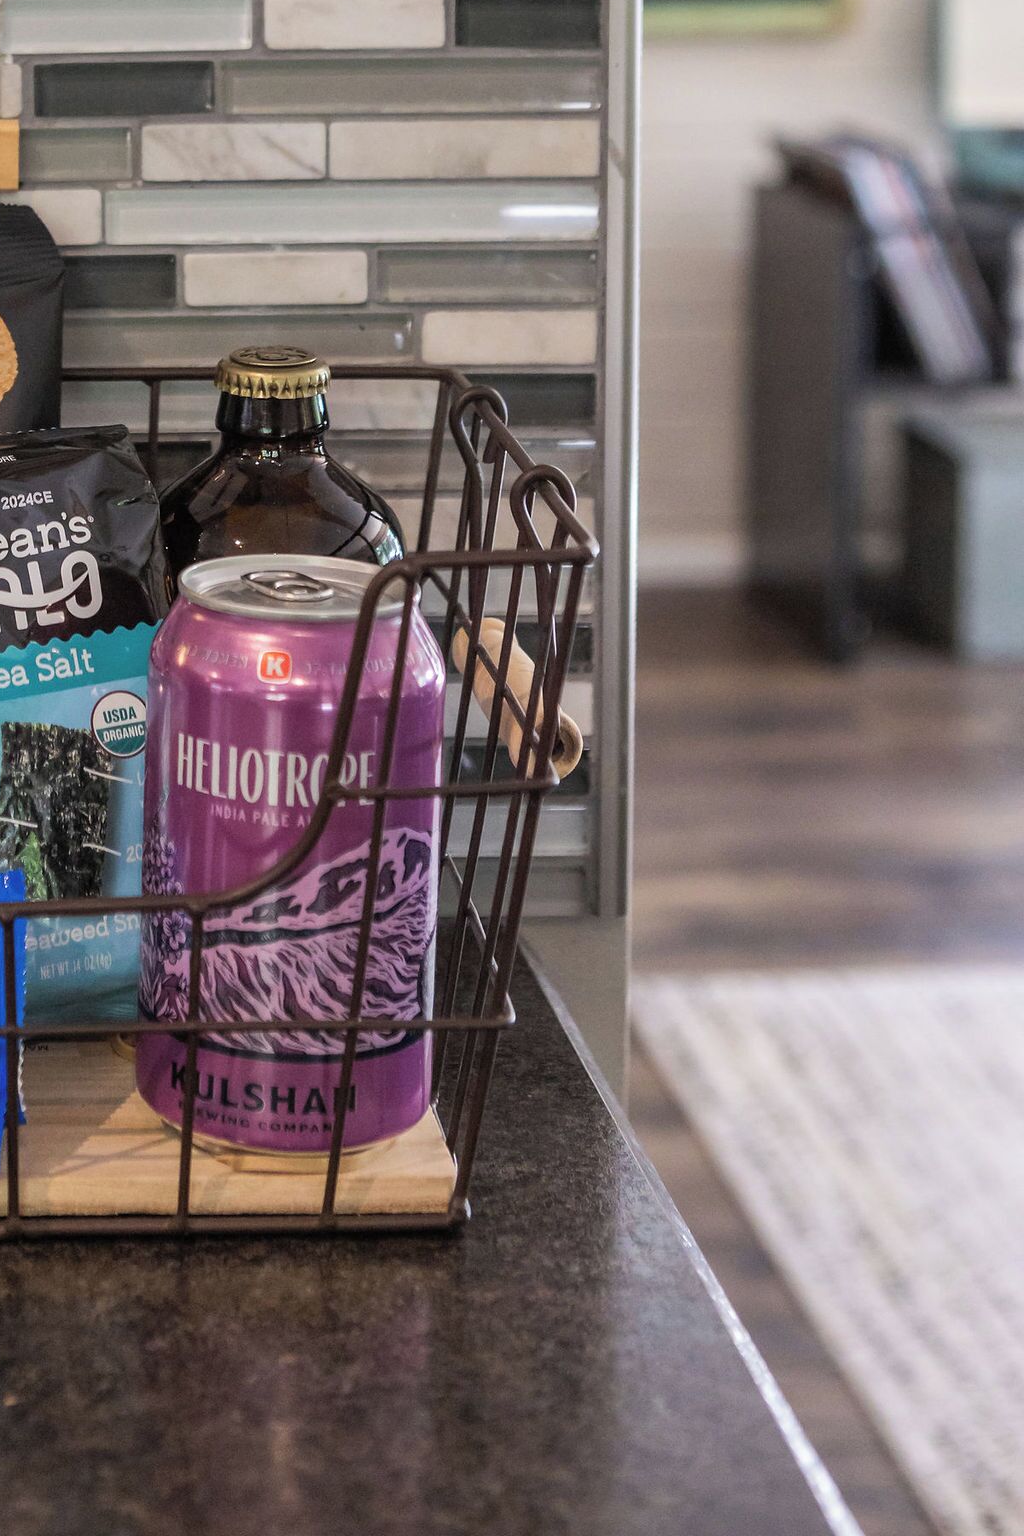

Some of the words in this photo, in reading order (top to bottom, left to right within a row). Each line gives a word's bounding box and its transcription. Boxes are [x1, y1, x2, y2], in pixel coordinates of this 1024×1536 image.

[1, 490, 54, 511] 2024CE
[35, 648, 95, 682] Salt
[265, 656, 283, 677] K
[102, 706, 137, 724] USDA
[103, 724, 145, 744] ORGANIC
[211, 803, 247, 823] INDIA
[252, 812, 290, 828] PALE
[41, 963, 56, 980] NET
[258, 1120, 334, 1135] COMPAN
